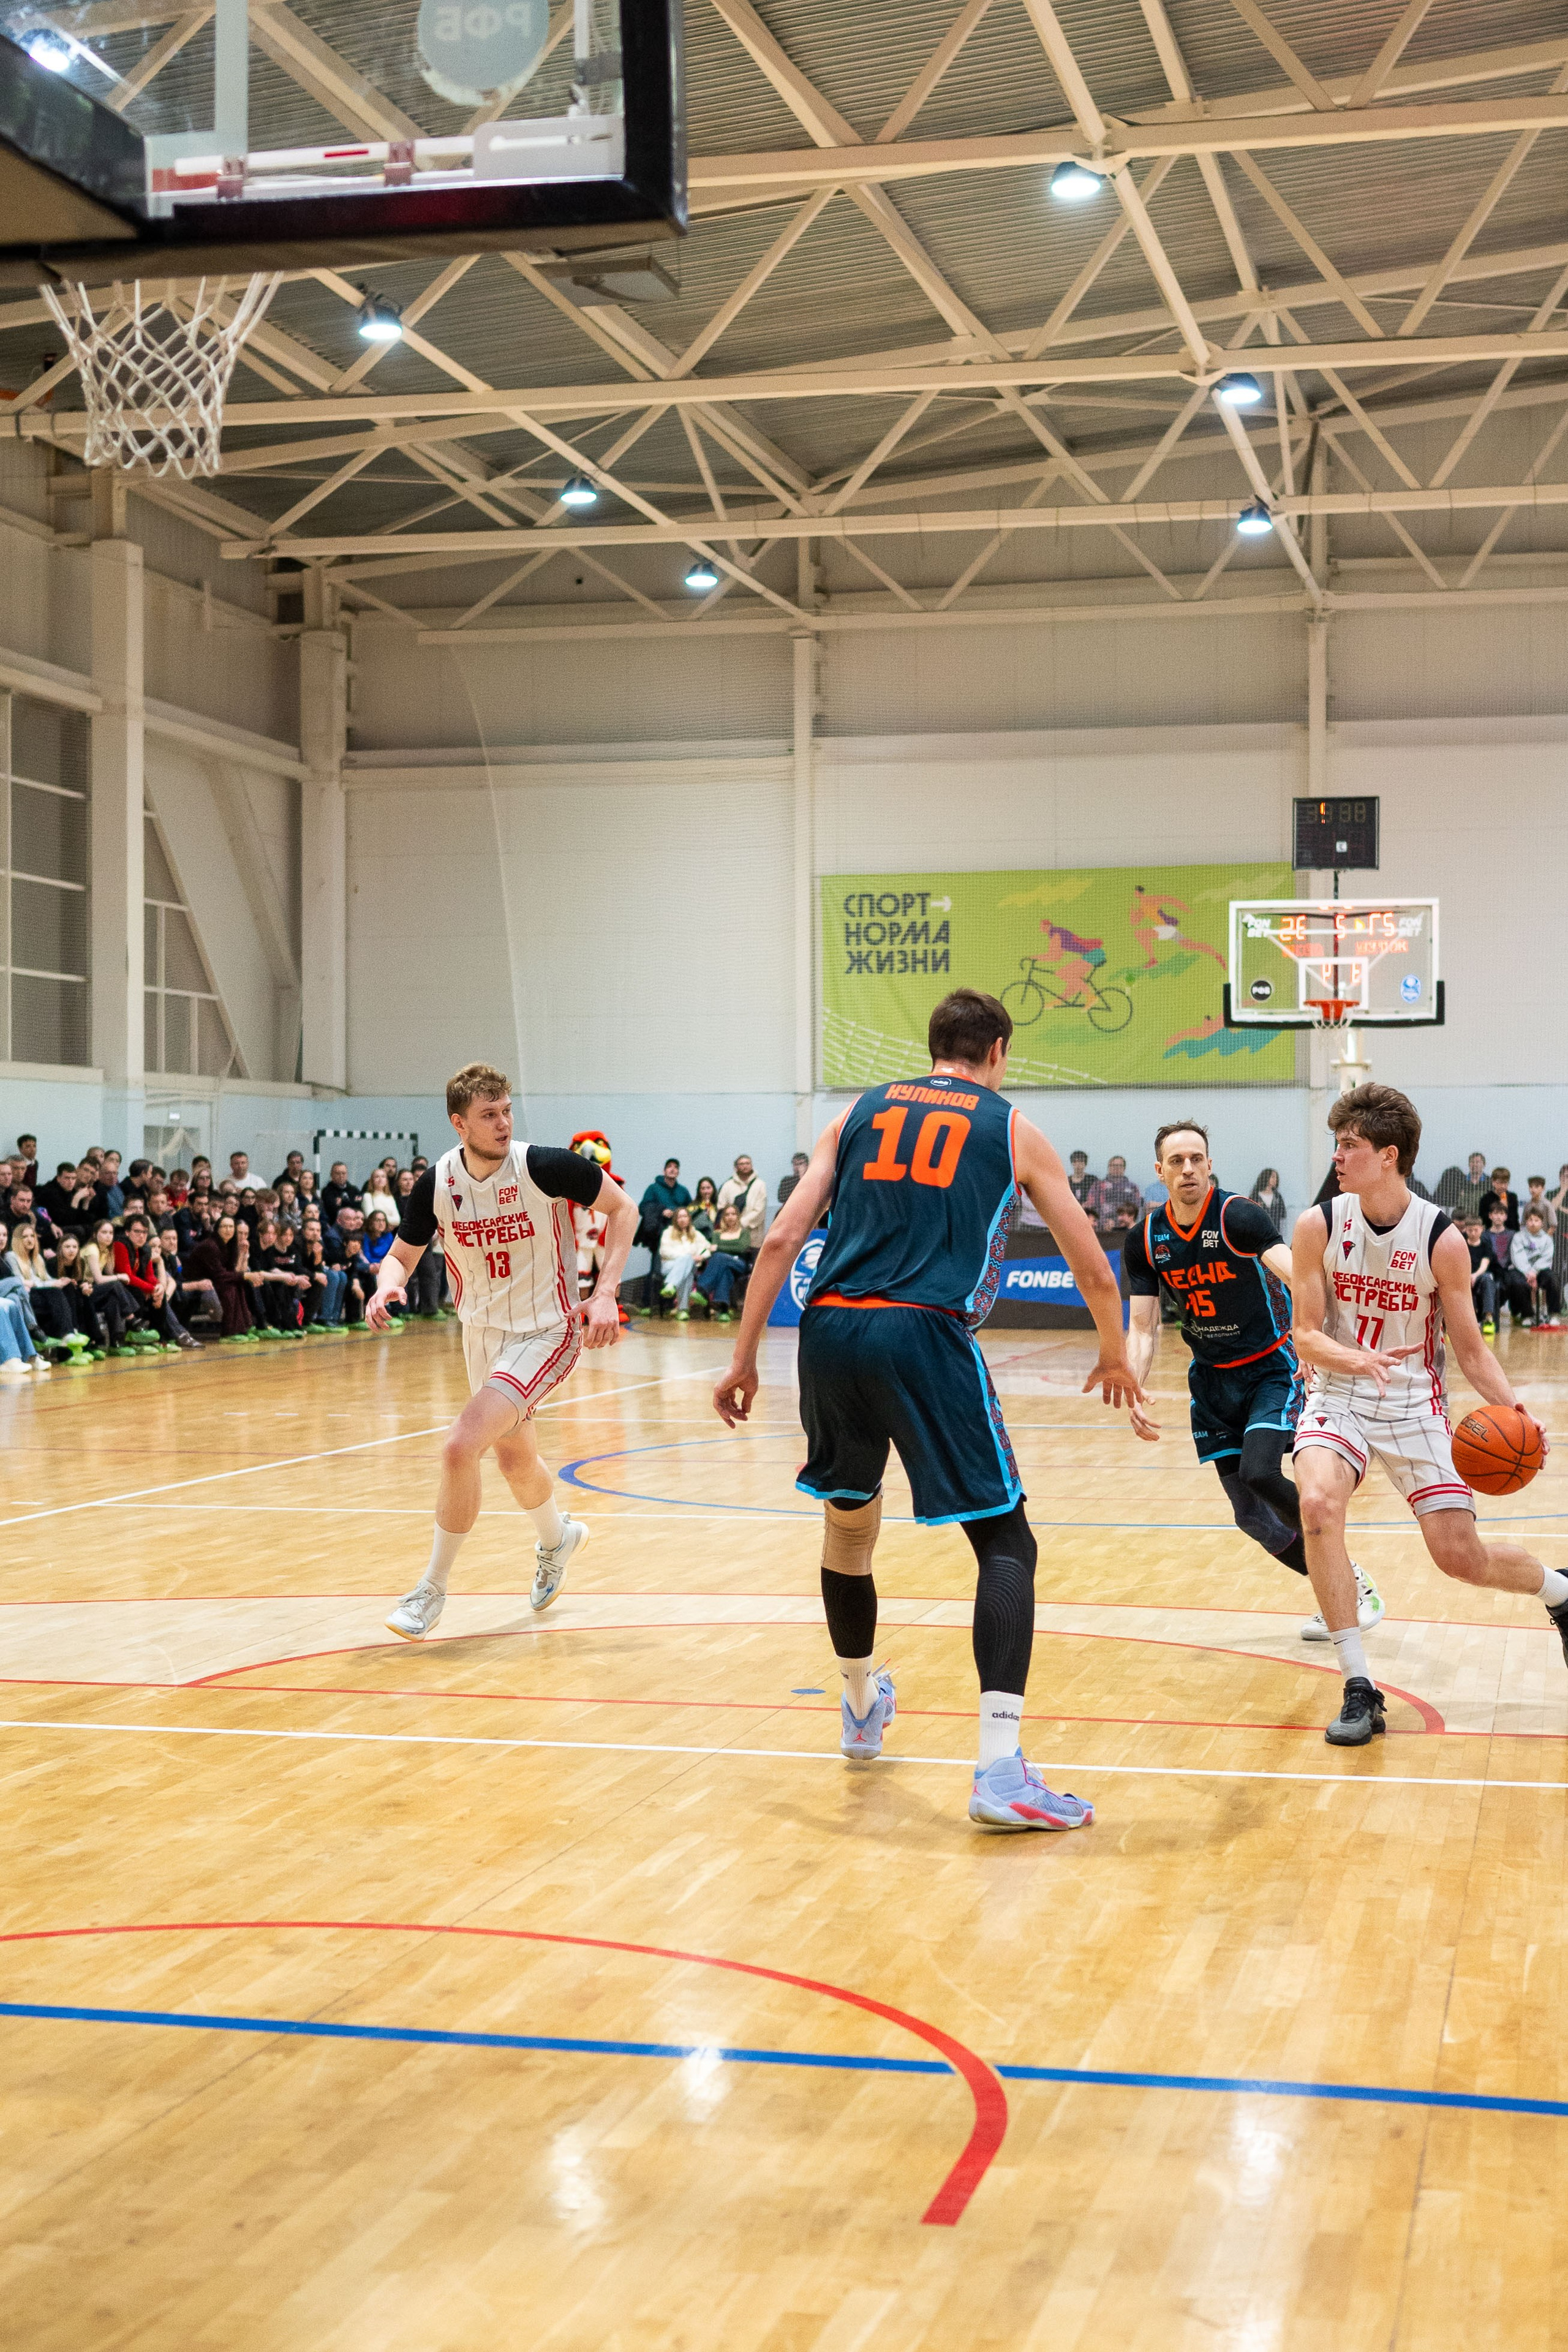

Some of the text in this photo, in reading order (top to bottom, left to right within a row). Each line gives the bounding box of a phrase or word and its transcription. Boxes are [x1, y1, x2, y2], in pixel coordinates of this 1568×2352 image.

[843, 892, 930, 918] СПОРТ
[845, 921, 950, 945] НОРМА
[845, 949, 949, 974] ЖИЗНИ
[884, 1084, 980, 1111] КУЛИКОВ
[862, 1106, 971, 1188] 10
[499, 1185, 518, 1197] FON
[499, 1194, 518, 1205] BET
[451, 1211, 530, 1231] ЧЕБОКСАРСКИЕ
[453, 1221, 535, 1247] ЯСТРЕБЫ
[1202, 1230, 1219, 1239] FON
[1203, 1239, 1219, 1248] BET
[486, 1251, 511, 1278] 13
[1390, 1259, 1413, 1270] BET
[1393, 1250, 1416, 1261] FON
[1006, 1270, 1074, 1288] FONBE
[1332, 1271, 1418, 1295] ЧЕБОКСАРСКИЕ
[1186, 1290, 1216, 1316] 15
[1333, 1281, 1419, 1311] ЯСТРЕБЫ
[1198, 1324, 1239, 1333] НАДЕЖДА
[1356, 1314, 1384, 1350] 77
